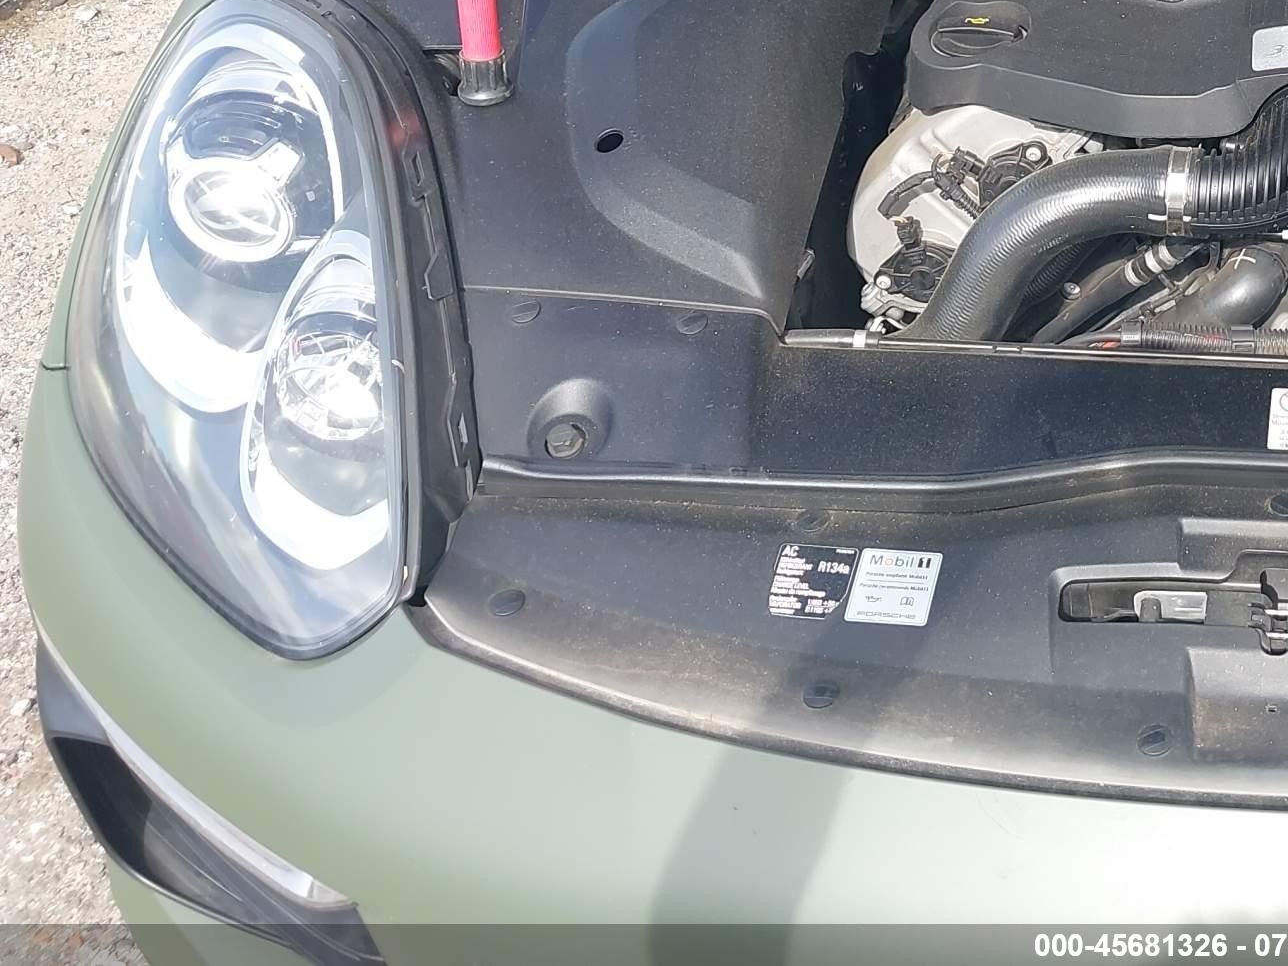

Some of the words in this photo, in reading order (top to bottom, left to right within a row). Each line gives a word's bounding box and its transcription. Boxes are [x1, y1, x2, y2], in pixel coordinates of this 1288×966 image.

[782, 545, 799, 556] AC
[869, 554, 915, 568] Mobil
[818, 561, 850, 574] R134a
[857, 611, 916, 619] PORSCHE
